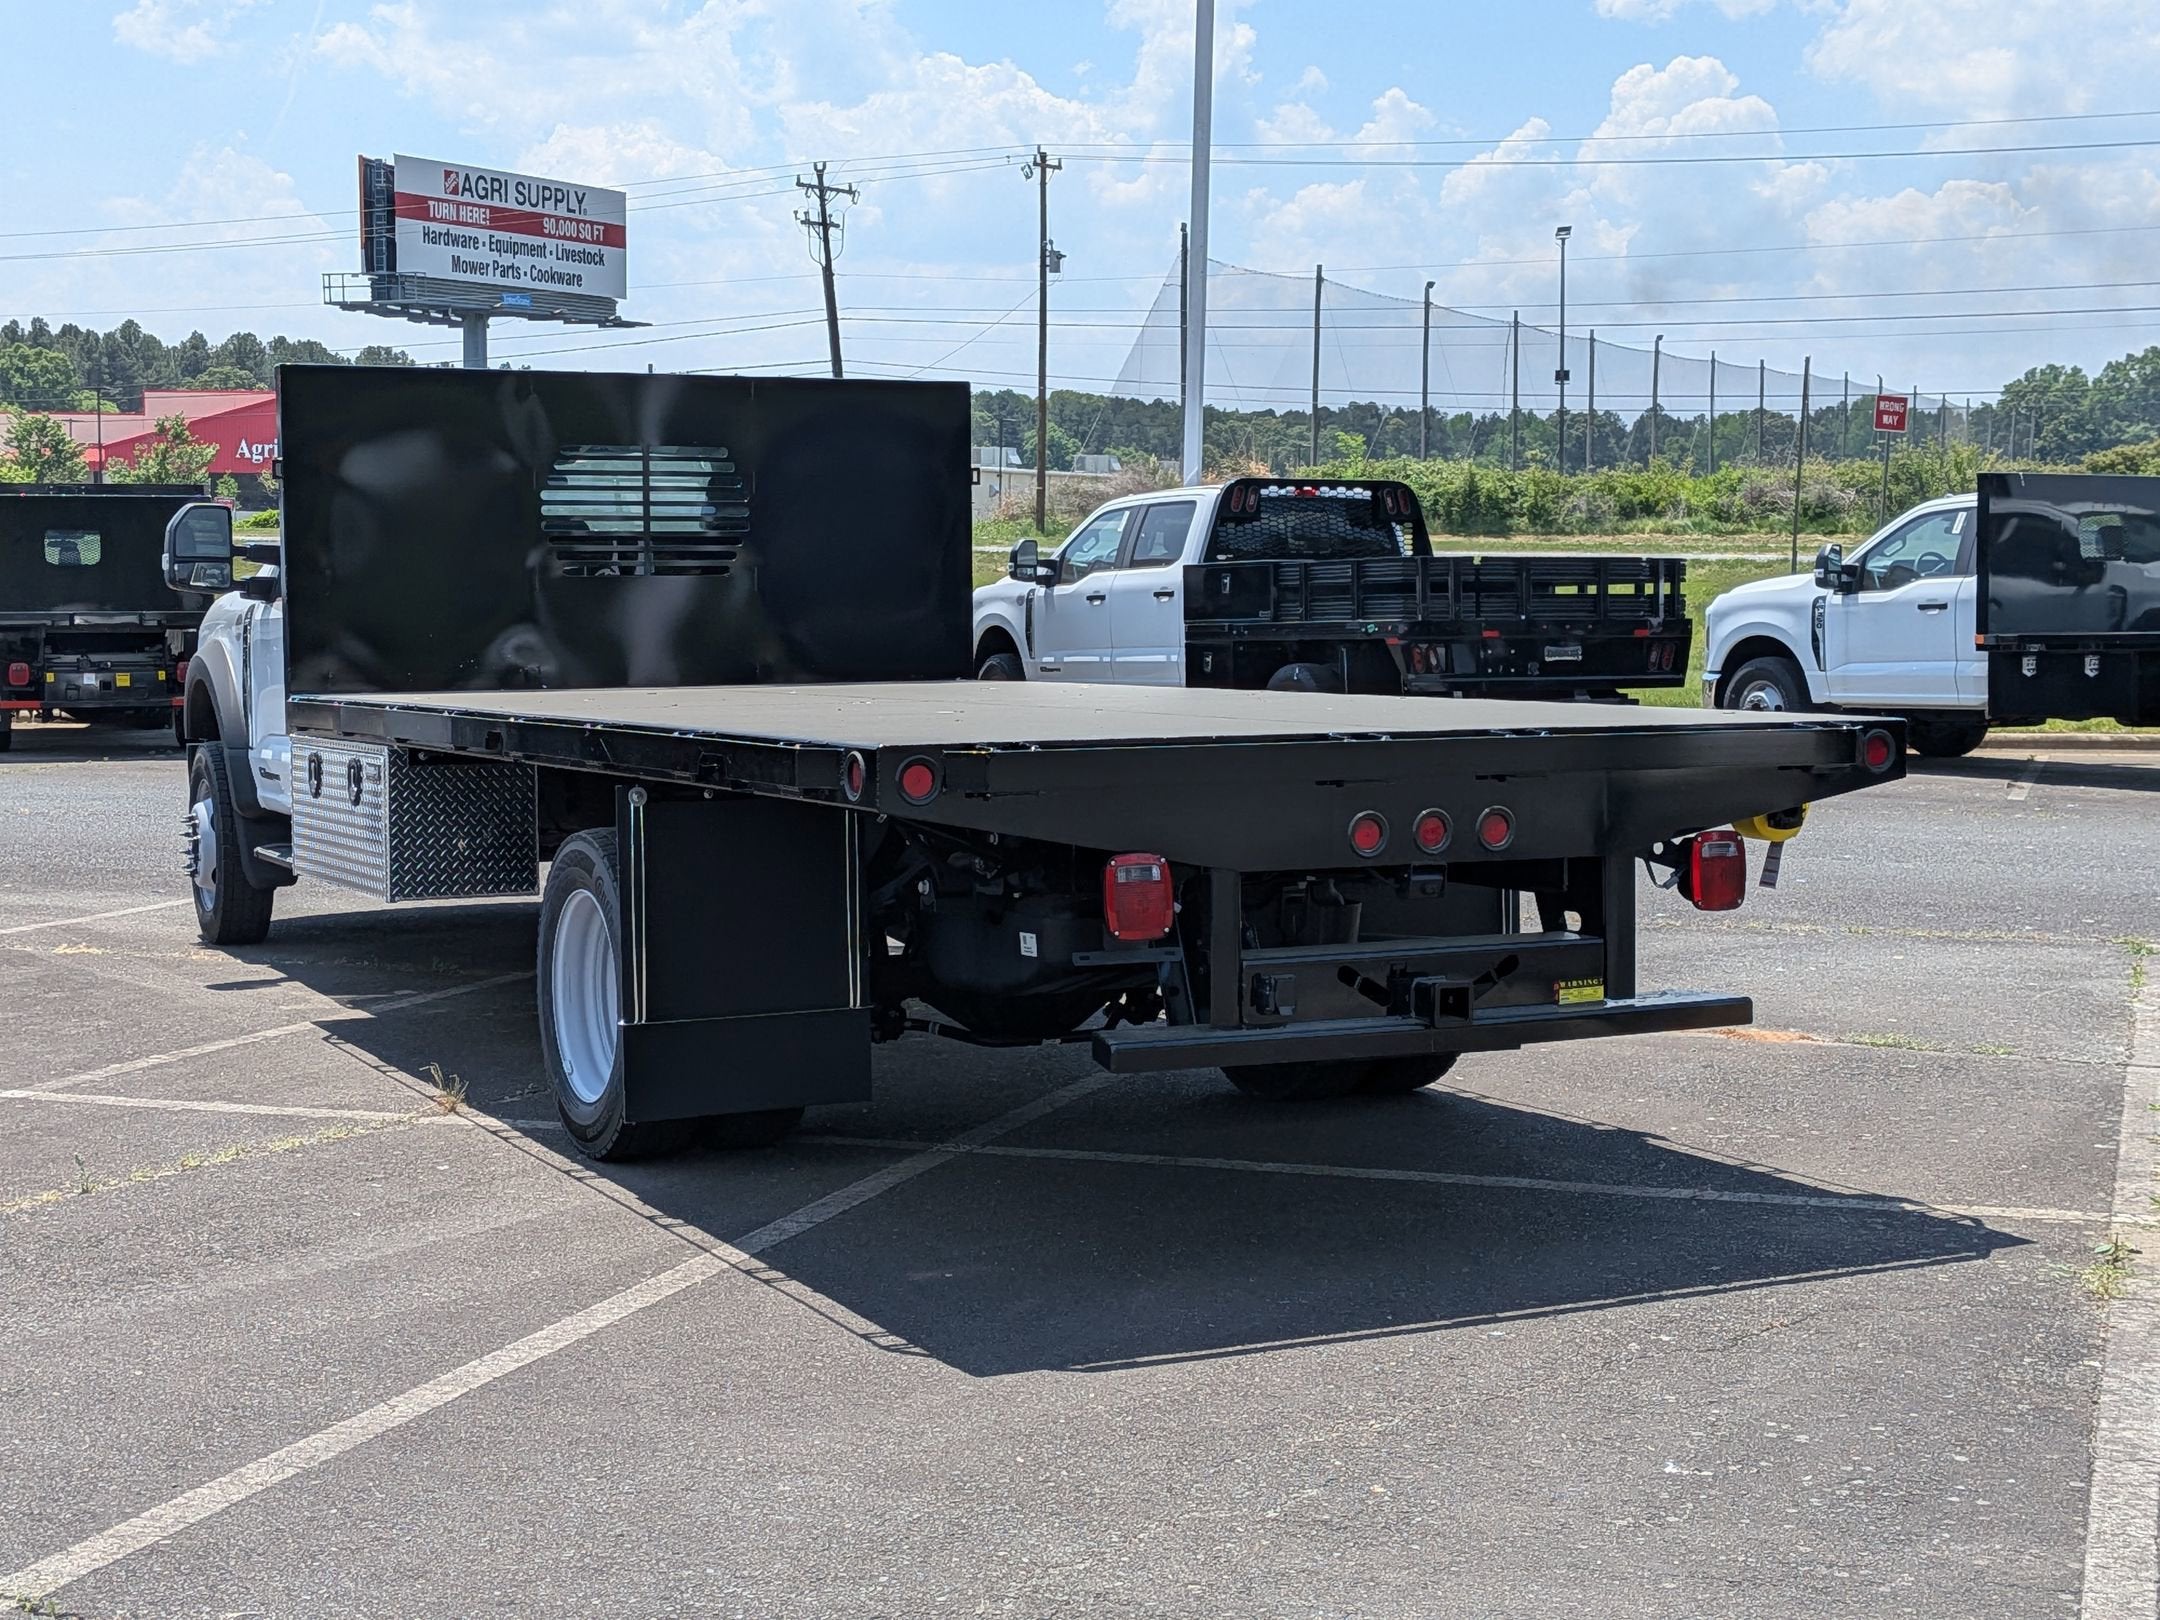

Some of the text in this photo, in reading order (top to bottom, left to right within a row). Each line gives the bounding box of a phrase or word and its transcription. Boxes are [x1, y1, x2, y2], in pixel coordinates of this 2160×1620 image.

[460, 172, 509, 204] AGRI
[514, 180, 587, 216] SUPPLY
[427, 200, 490, 225] TURN HERE!
[542, 217, 605, 242] 90,000 SQ FT
[422, 225, 606, 267] Hardware Equipment Livestock
[451, 254, 583, 287] Mower Parts Cookware
[1879, 400, 1905, 413] WRONG
[1882, 414, 1899, 426] WAY
[235, 438, 279, 464] Agri
